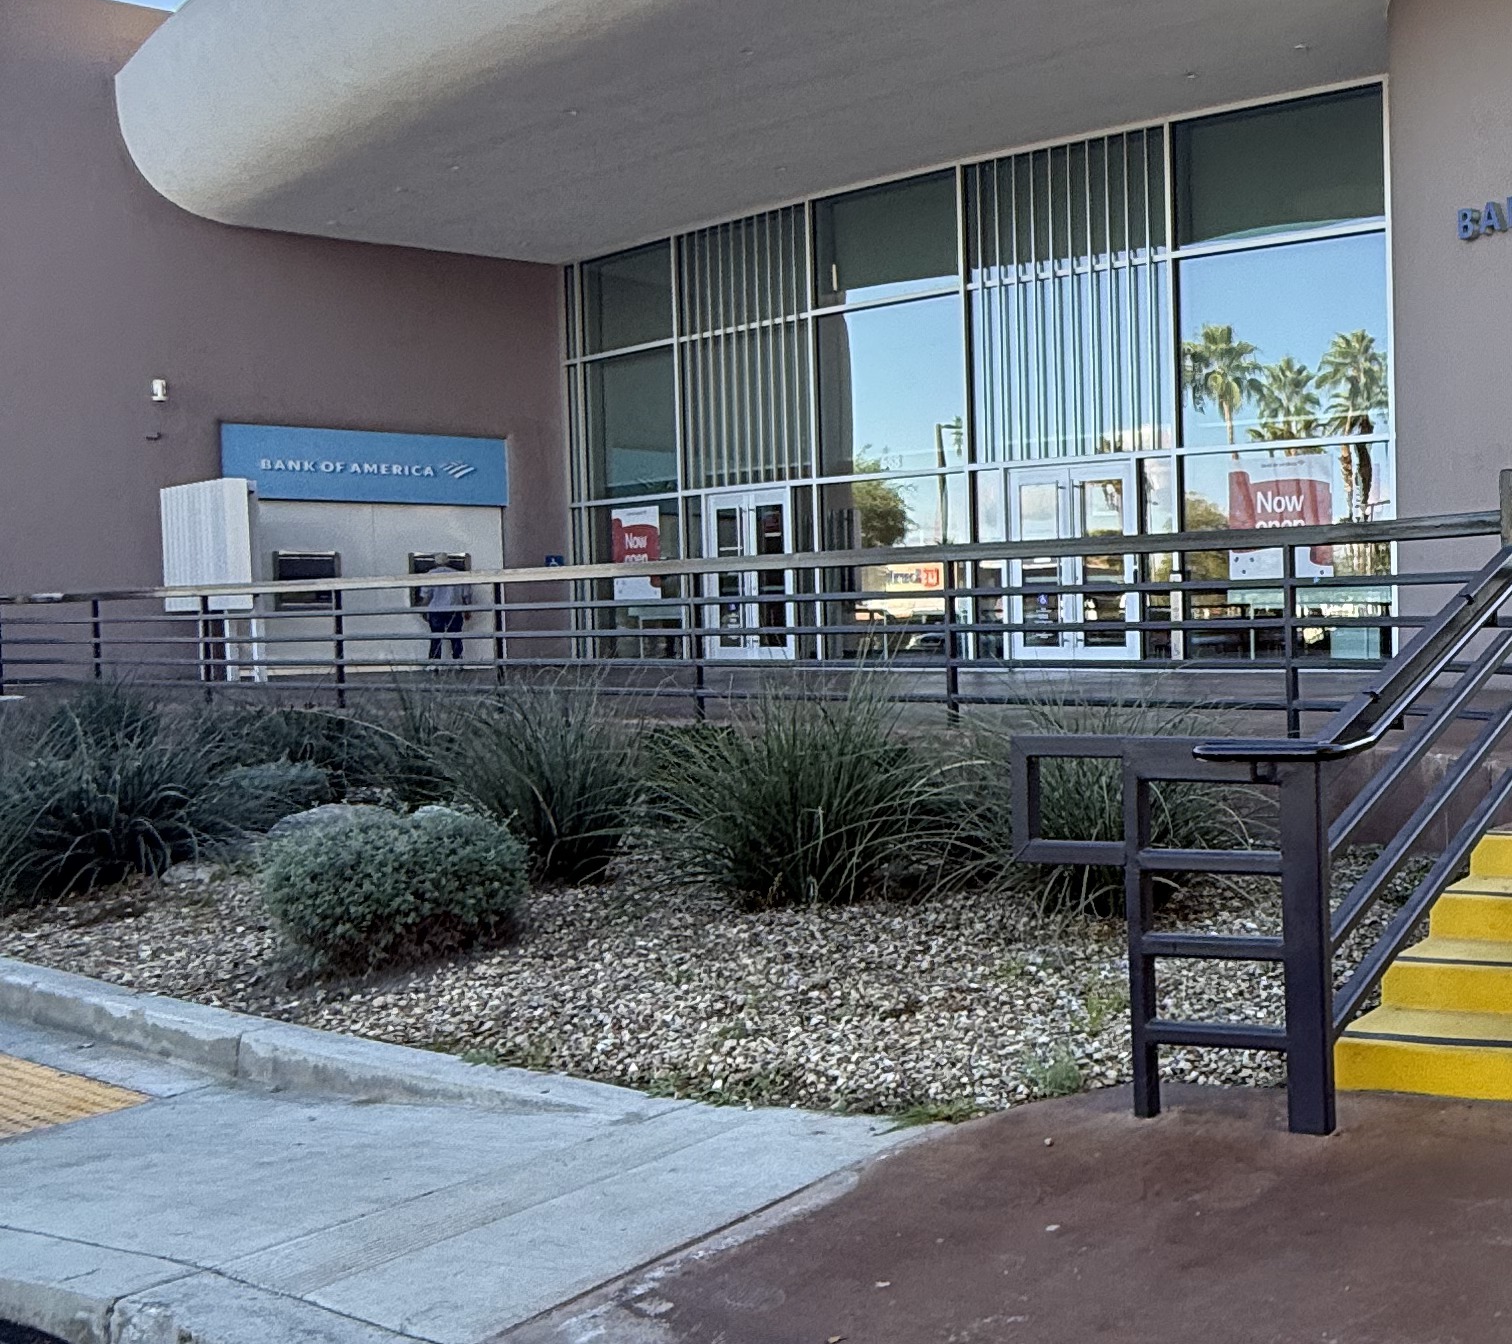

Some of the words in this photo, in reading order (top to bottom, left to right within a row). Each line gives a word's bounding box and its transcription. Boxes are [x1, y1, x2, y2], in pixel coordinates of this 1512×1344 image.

[260, 459, 315, 472] BANK
[320, 460, 345, 473] OF
[350, 463, 435, 477] AMERICA
[1256, 490, 1305, 514] Now
[624, 532, 648, 550] Now
